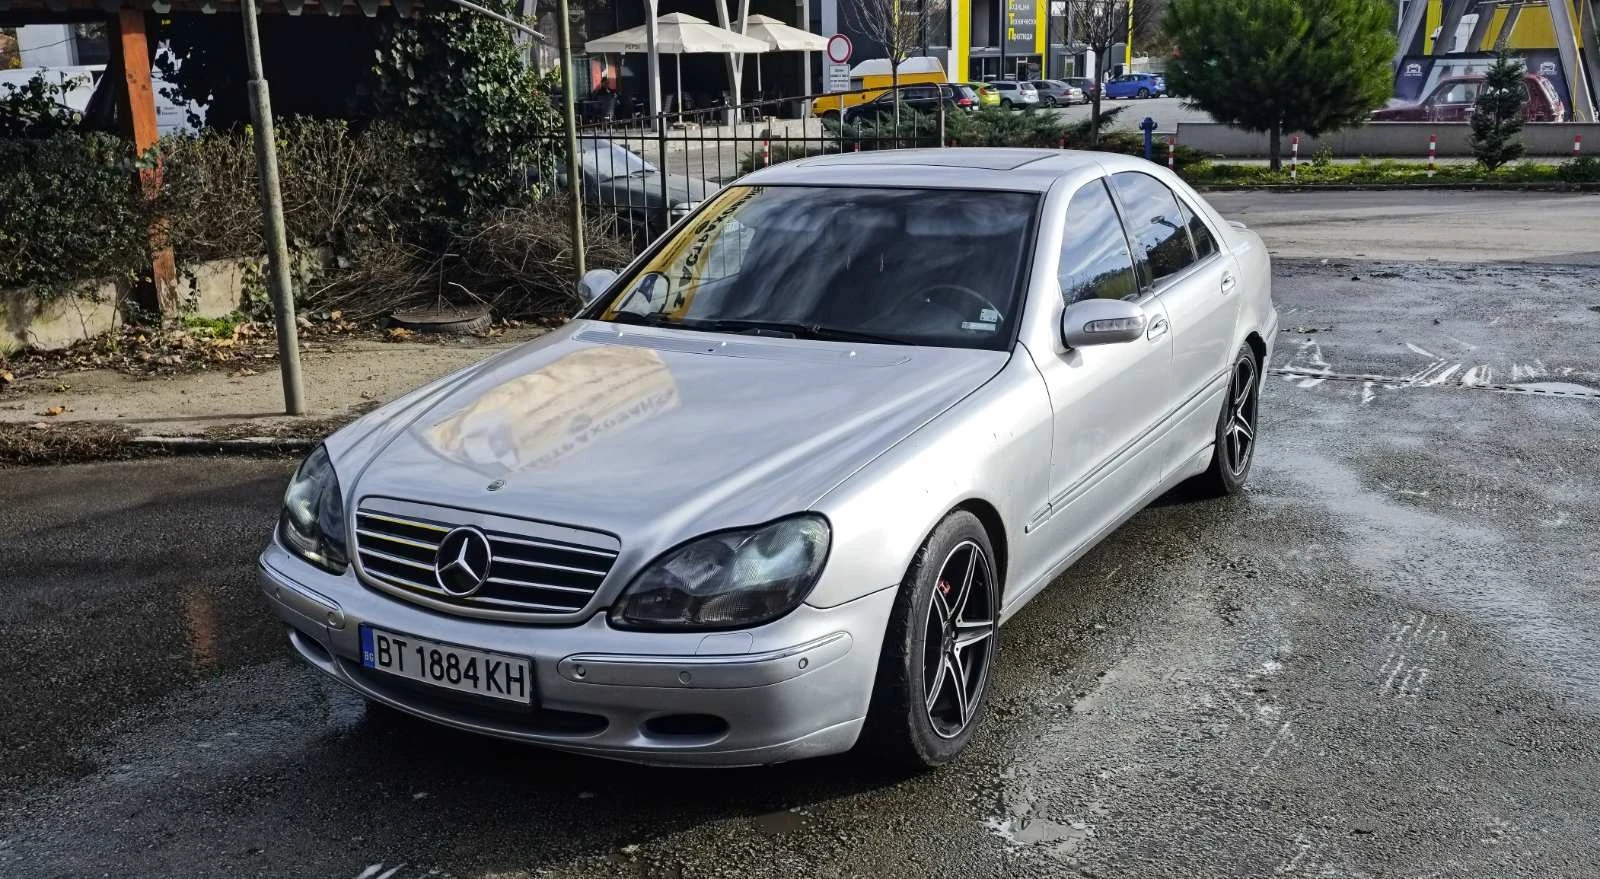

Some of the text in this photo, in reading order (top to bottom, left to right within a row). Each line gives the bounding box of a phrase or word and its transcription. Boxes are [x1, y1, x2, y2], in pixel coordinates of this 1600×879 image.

[376, 635, 525, 697] BT 1884 KH
